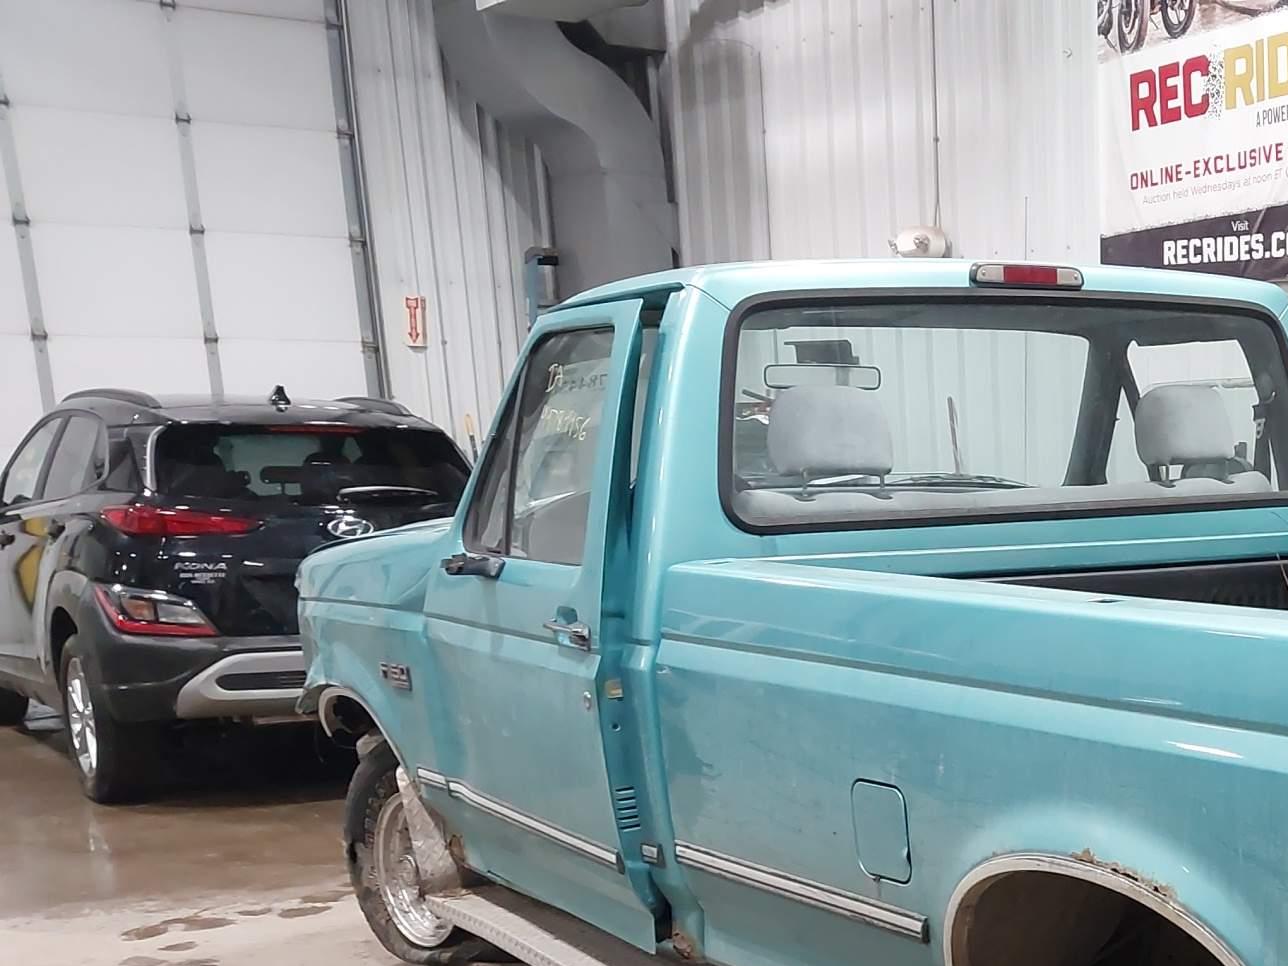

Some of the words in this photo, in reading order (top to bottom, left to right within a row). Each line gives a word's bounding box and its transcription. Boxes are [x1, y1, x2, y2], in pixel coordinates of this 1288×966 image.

[1131, 142, 1284, 190] ONLINE-EXCLUSIVE
[1142, 191, 1171, 205] Auction
[1173, 187, 1189, 201] held
[1191, 179, 1241, 198] Wednesdays
[1243, 178, 1252, 188] at
[1253, 173, 1273, 187] noon
[1231, 220, 1249, 231] Visit
